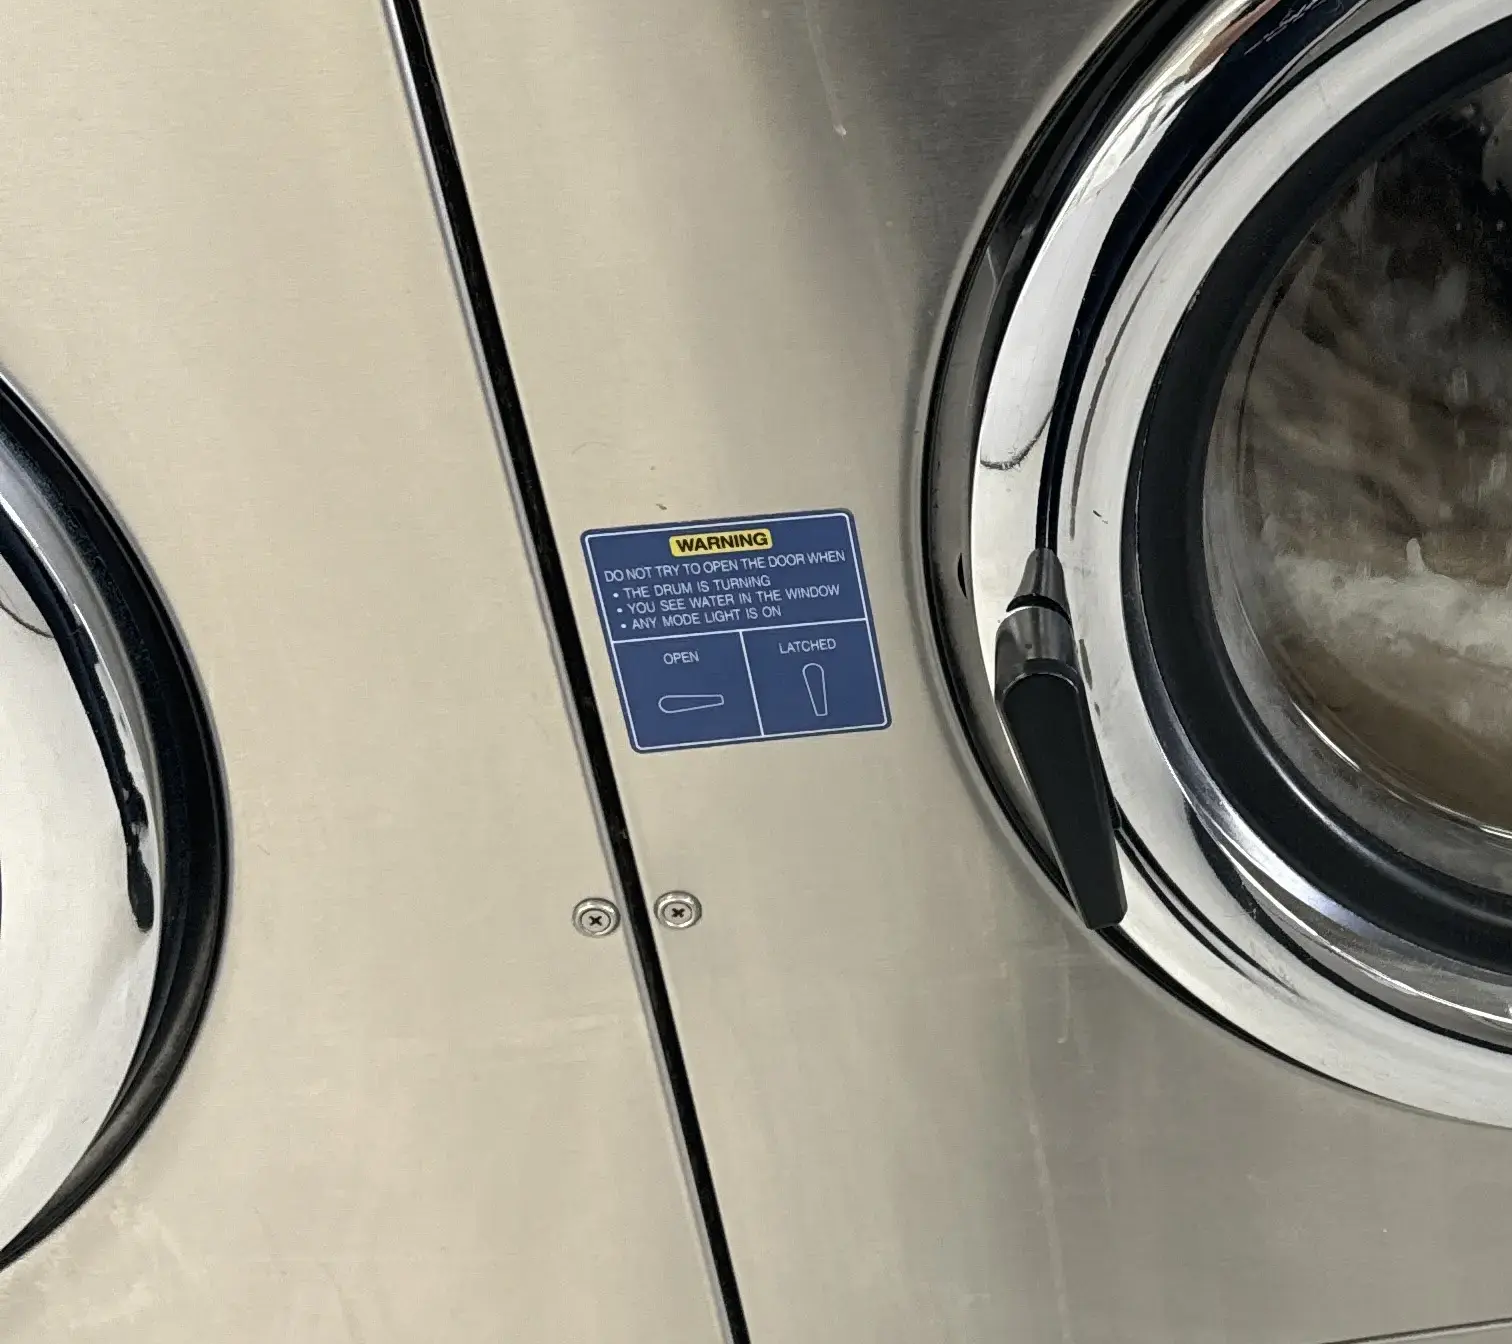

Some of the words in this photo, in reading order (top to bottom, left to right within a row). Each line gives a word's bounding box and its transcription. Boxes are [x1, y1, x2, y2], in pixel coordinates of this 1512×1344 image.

[676, 532, 768, 552] WARNING
[604, 569, 624, 582] DO
[625, 566, 652, 580] NOT
[654, 564, 679, 578] TRY
[682, 562, 700, 575] TO
[703, 559, 738, 573] OPEN
[740, 556, 766, 570] THE
[768, 553, 805, 567] DOOR
[807, 550, 846, 564] WHEN
[623, 586, 650, 599] THE
[654, 582, 692, 596] DRUM
[697, 580, 709, 592] IS
[713, 575, 771, 591] TURNING
[627, 601, 655, 614] YOU
[660, 598, 686, 612] SEE
[689, 594, 735, 609] WATER
[739, 592, 752, 604] IN
[755, 589, 782, 603] THE
[785, 584, 840, 600] WINDOW
[632, 617, 657, 630] ANY
[662, 613, 700, 627] MODE
[704, 608, 740, 624] LIGHT
[746, 607, 758, 619] IS
[762, 605, 781, 618] ON
[663, 650, 699, 665] OPEN
[778, 638, 836, 655] LATCHED
